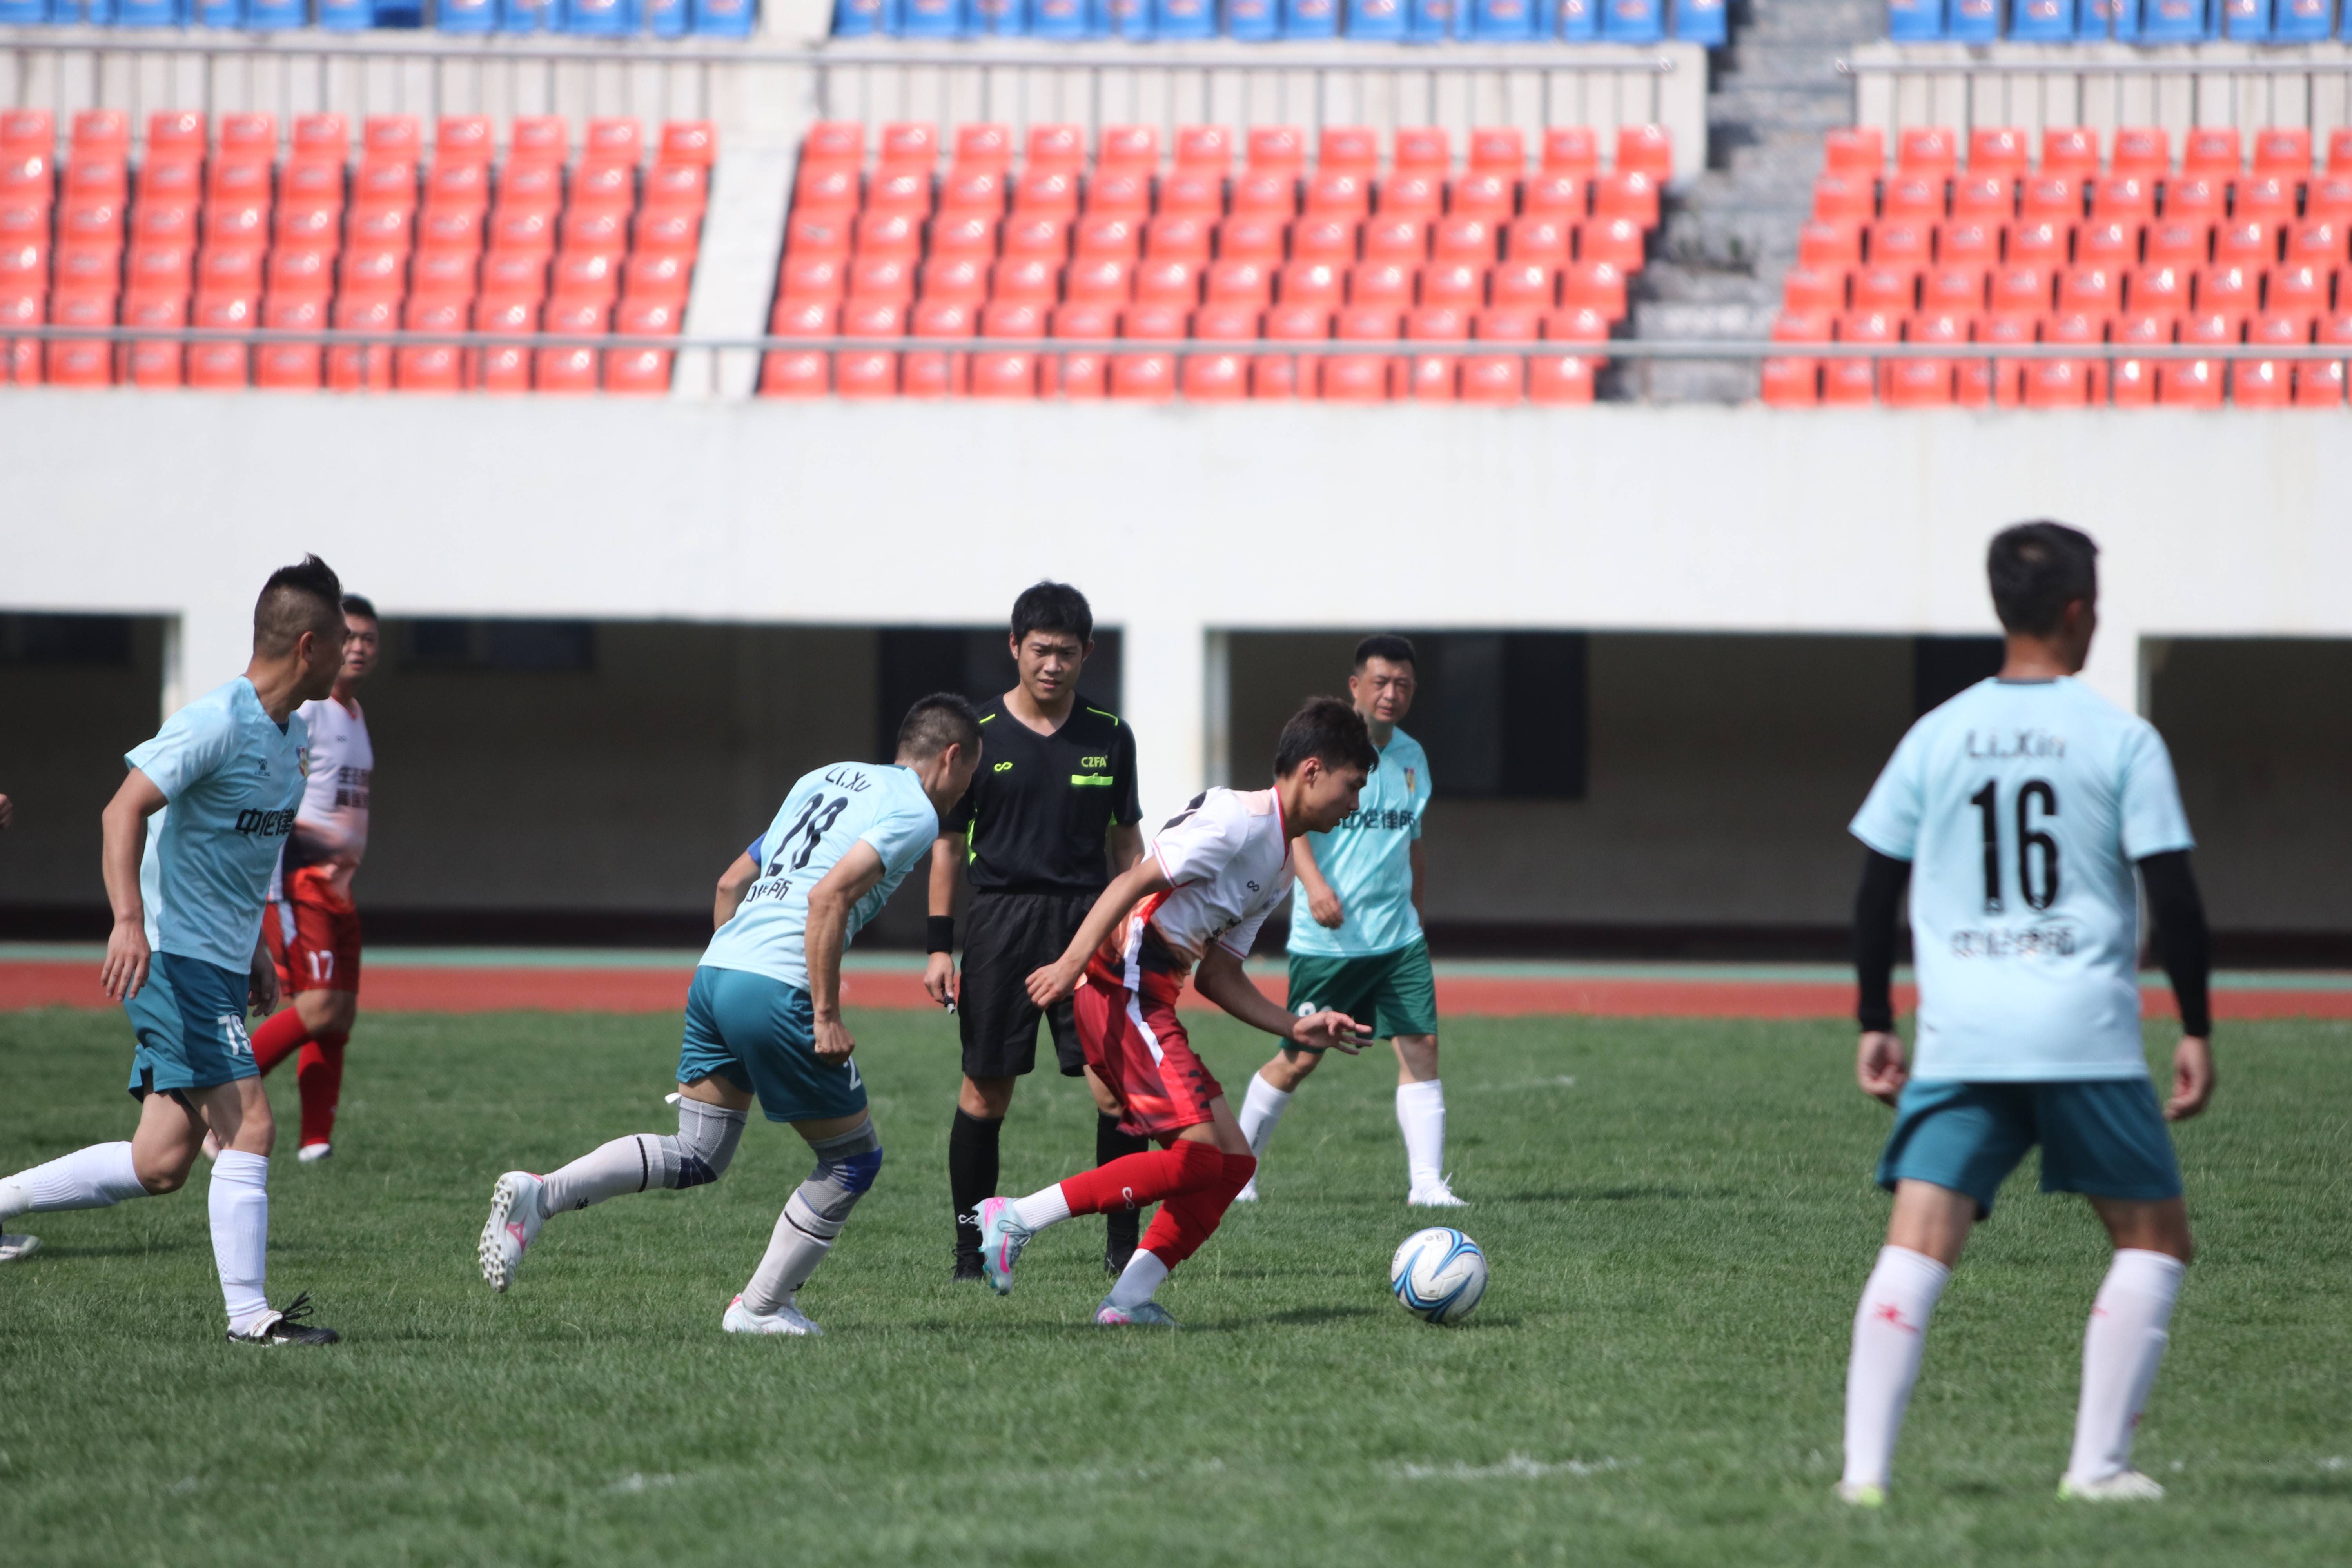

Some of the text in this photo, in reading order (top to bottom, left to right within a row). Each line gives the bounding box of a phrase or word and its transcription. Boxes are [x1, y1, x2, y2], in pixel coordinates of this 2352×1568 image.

[1081, 756, 1107, 767] CZFA
[1971, 776, 2059, 913] 16
[308, 950, 334, 982] 17
